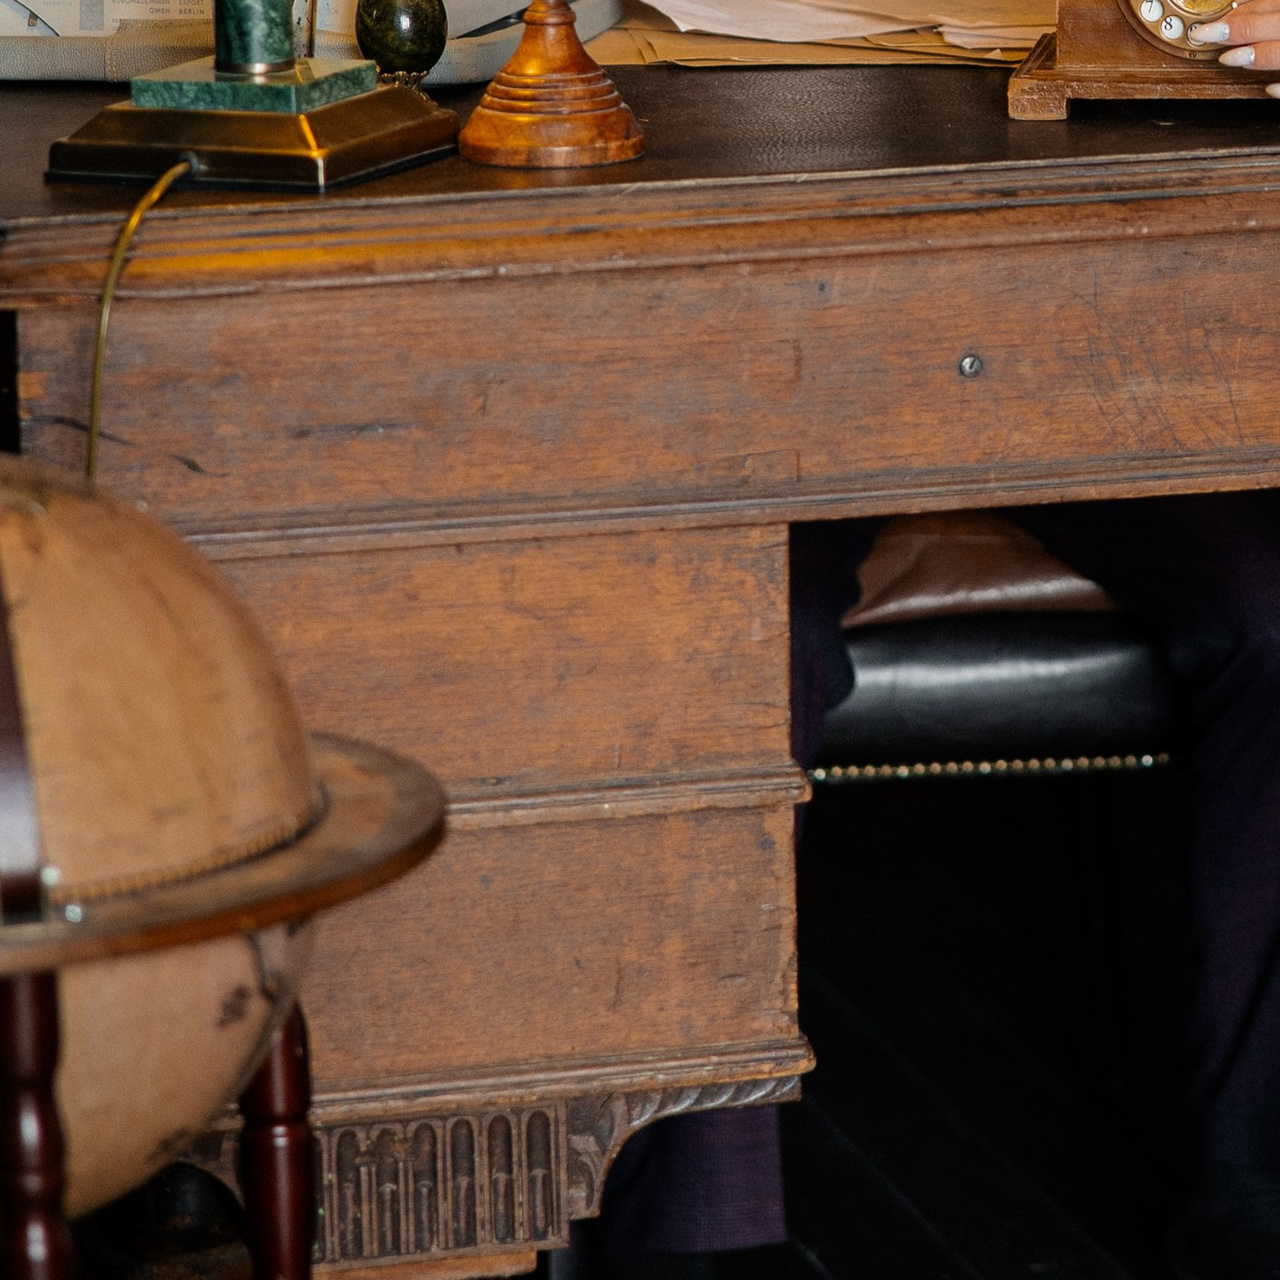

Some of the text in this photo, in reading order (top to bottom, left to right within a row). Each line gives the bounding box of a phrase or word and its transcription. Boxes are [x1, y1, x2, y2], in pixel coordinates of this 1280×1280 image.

[179, 7, 205, 15] BERLIN
[1146, 0, 1153, 14] 7
[1164, 17, 1173, 30] 8
